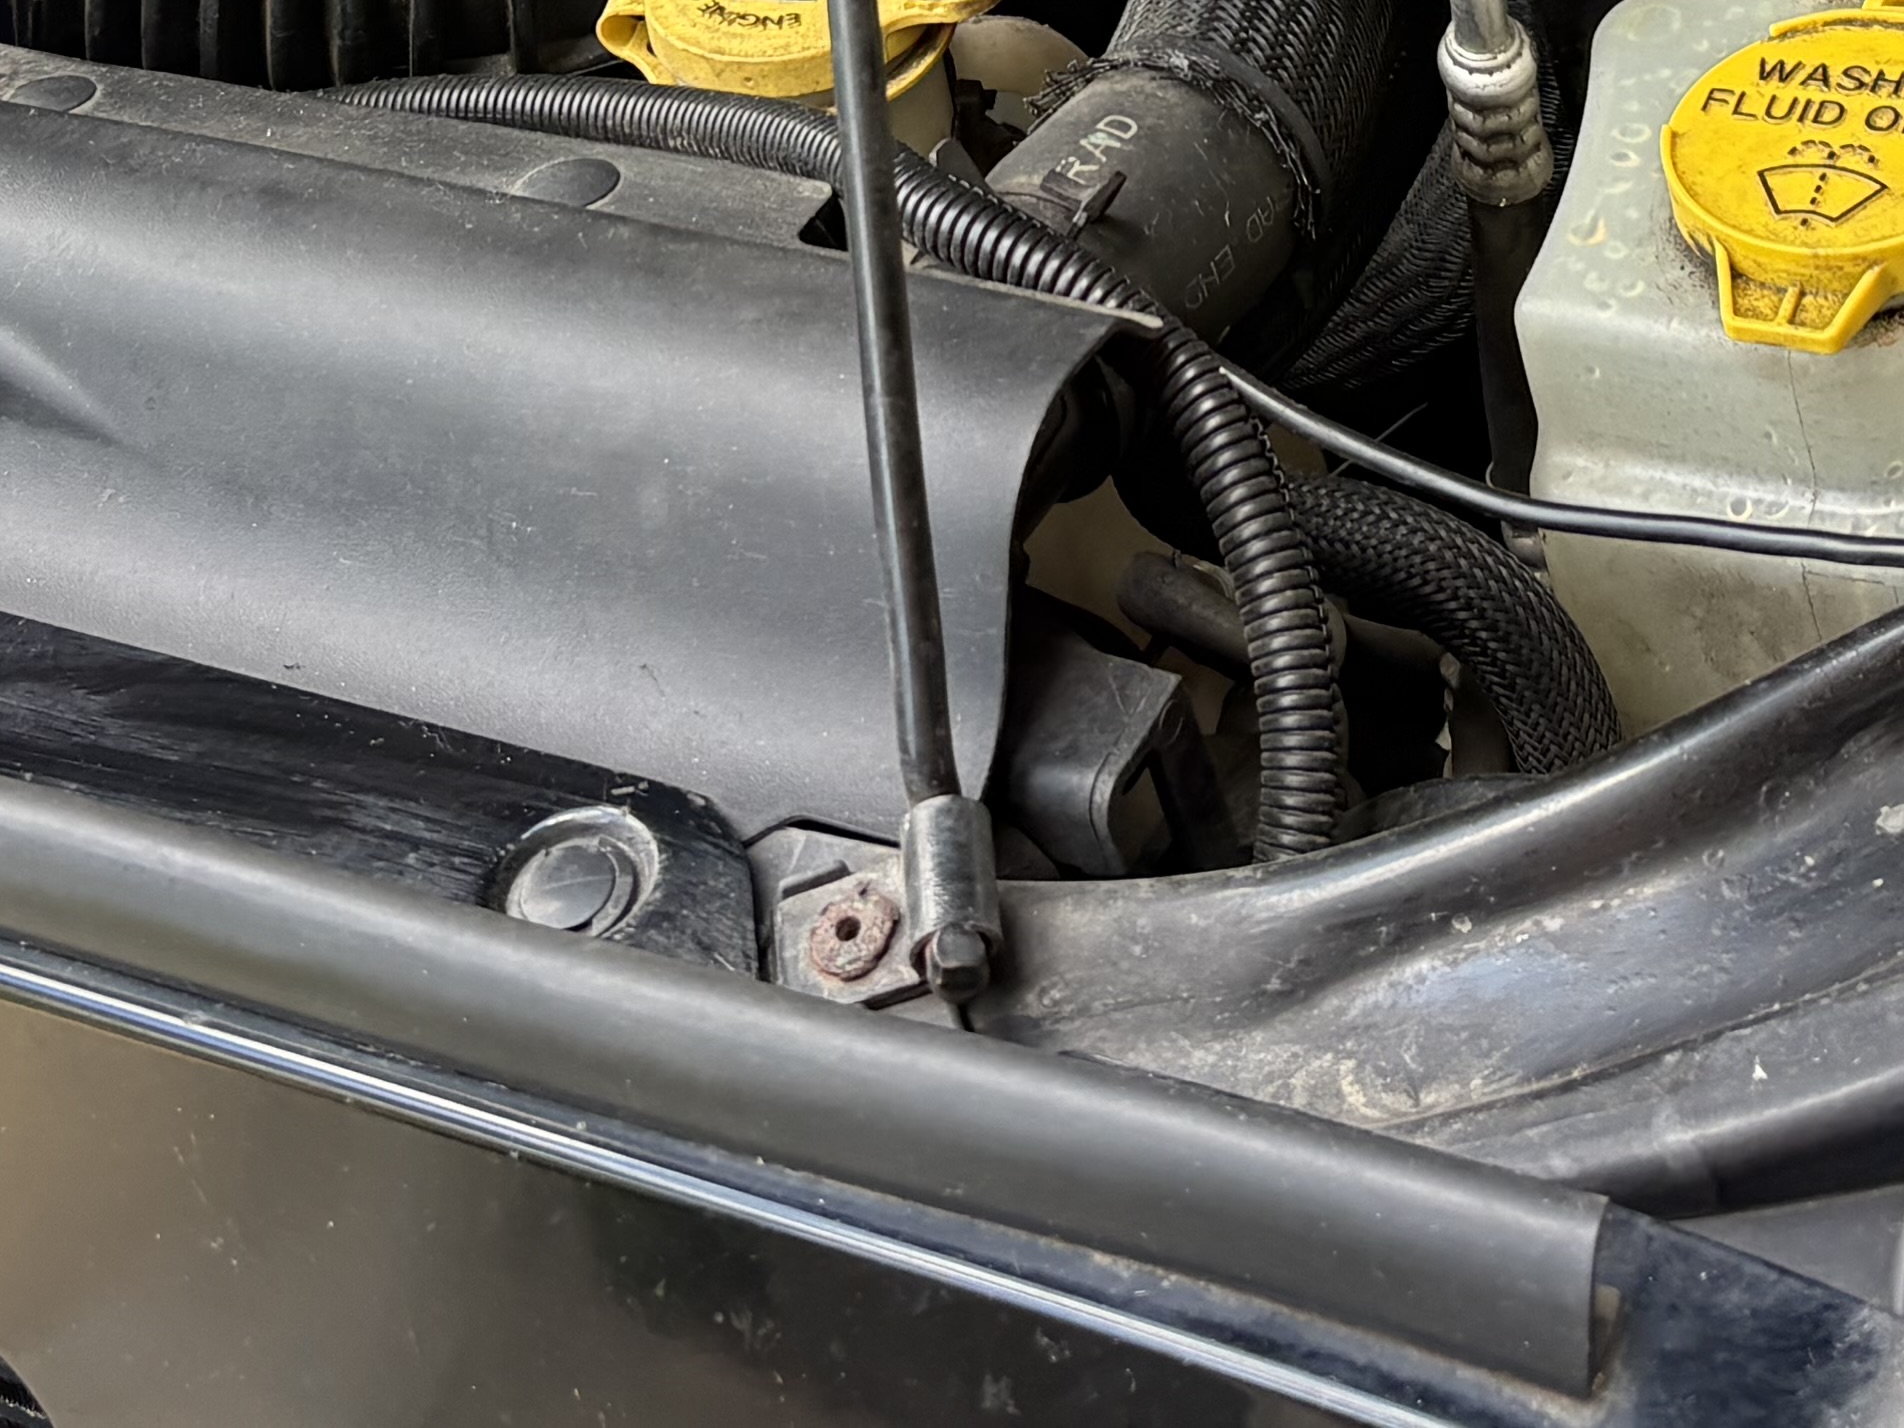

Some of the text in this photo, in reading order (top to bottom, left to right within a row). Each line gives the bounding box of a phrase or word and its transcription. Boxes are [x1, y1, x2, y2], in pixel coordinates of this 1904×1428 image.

[698, 0, 802, 31] ENGINE
[1700, 86, 1848, 130] FLUID
[1056, 114, 1138, 184] RAD
